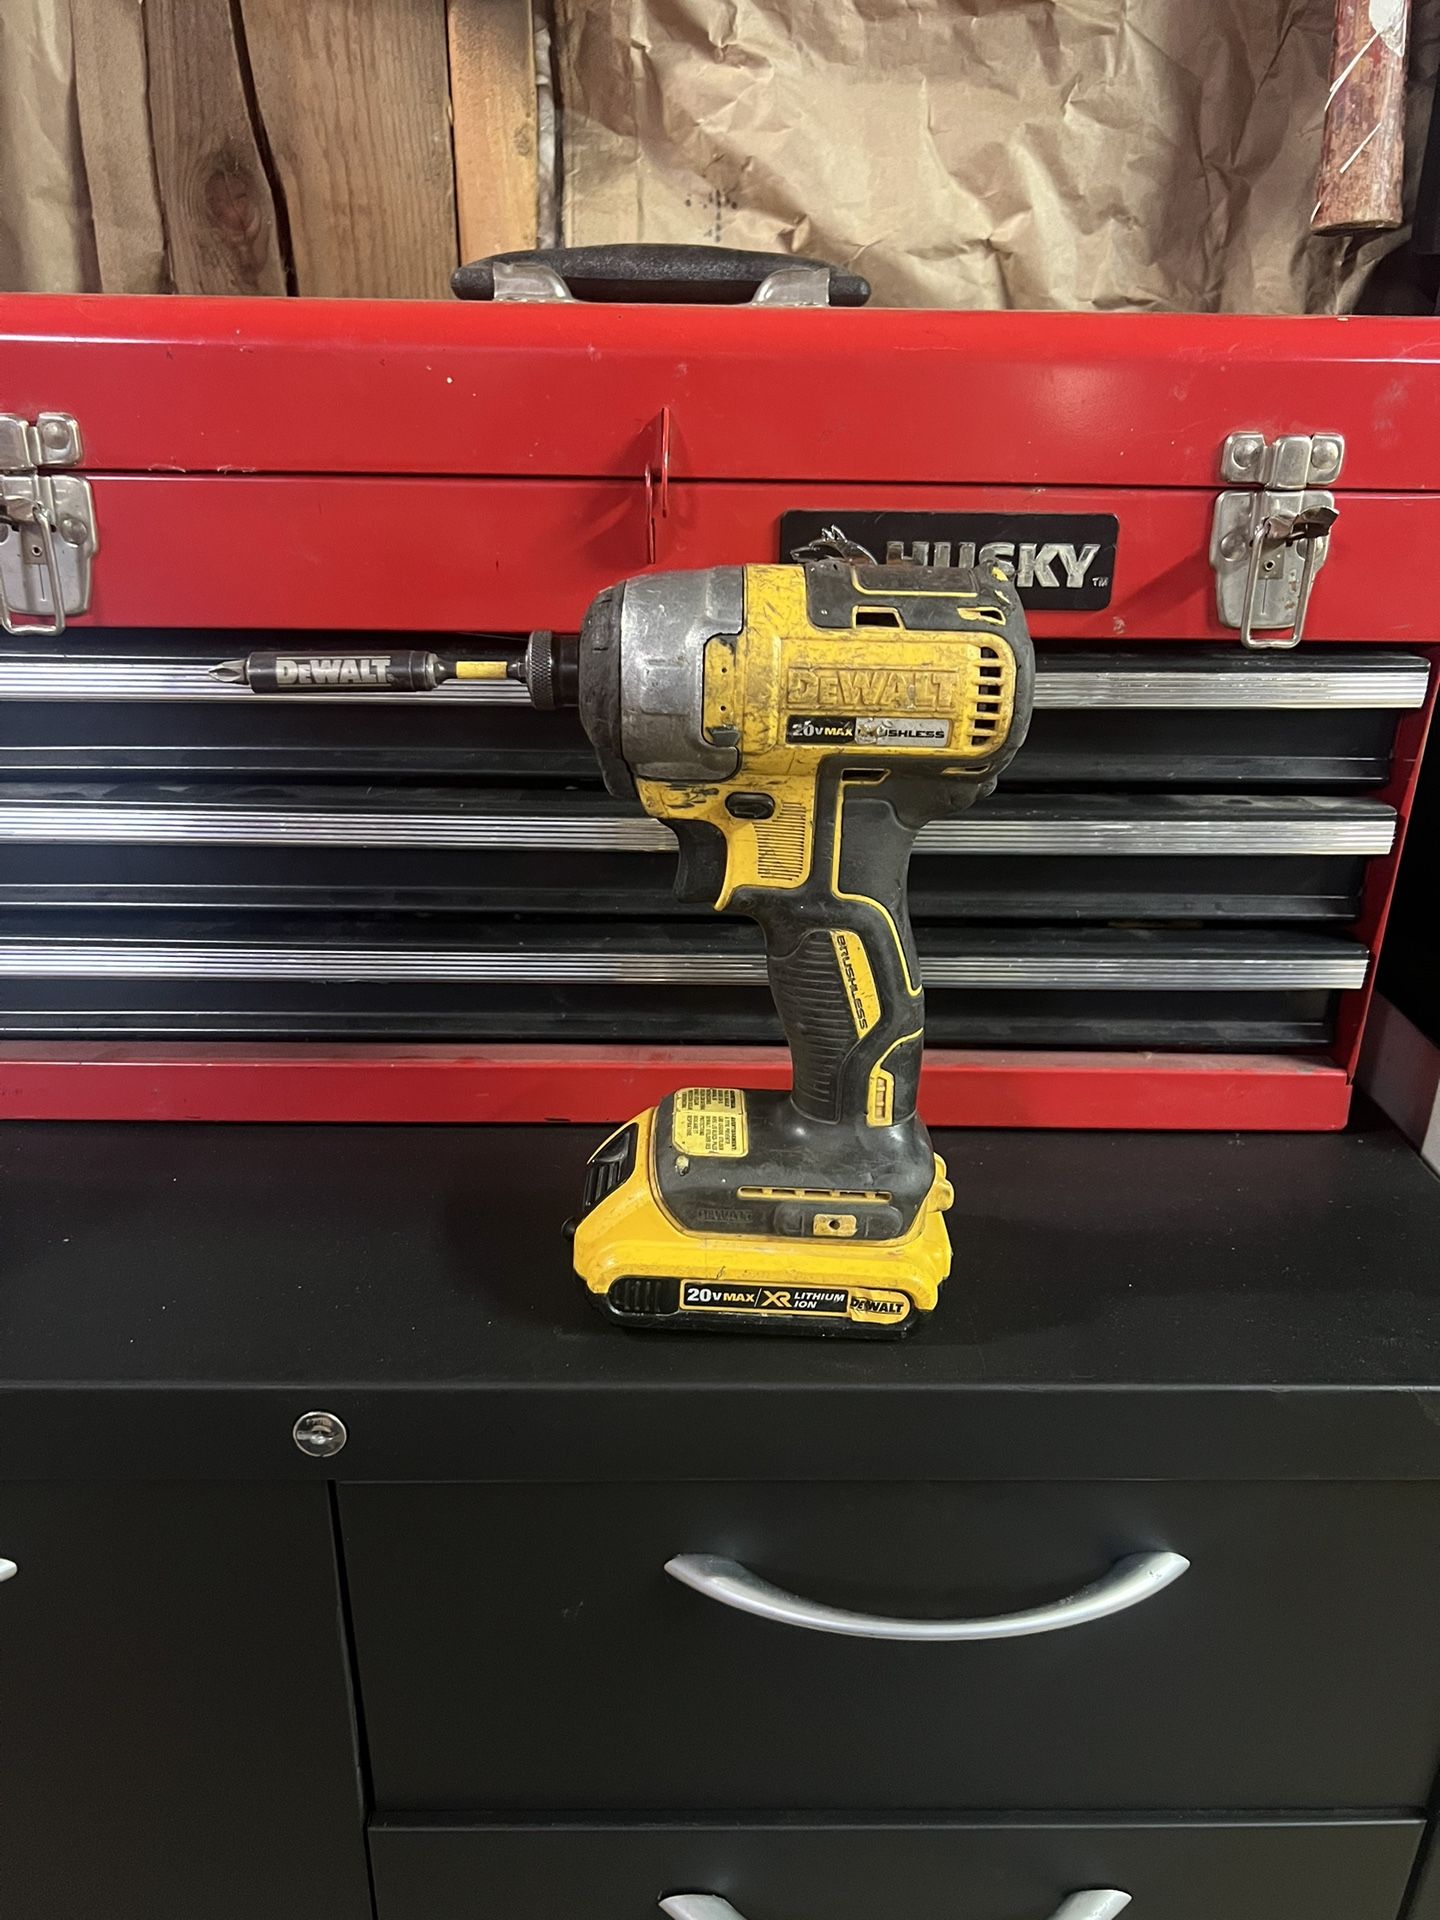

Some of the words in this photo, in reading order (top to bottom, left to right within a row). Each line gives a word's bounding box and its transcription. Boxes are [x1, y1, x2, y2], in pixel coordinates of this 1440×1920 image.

[276, 658, 391, 684] DEWALT
[787, 668, 957, 707] DEWALT
[836, 934, 868, 1030] BRUSHLESS
[762, 1290, 793, 1307] XR
[794, 1292, 846, 1302] LITHIUM
[794, 1301, 817, 1309] ION
